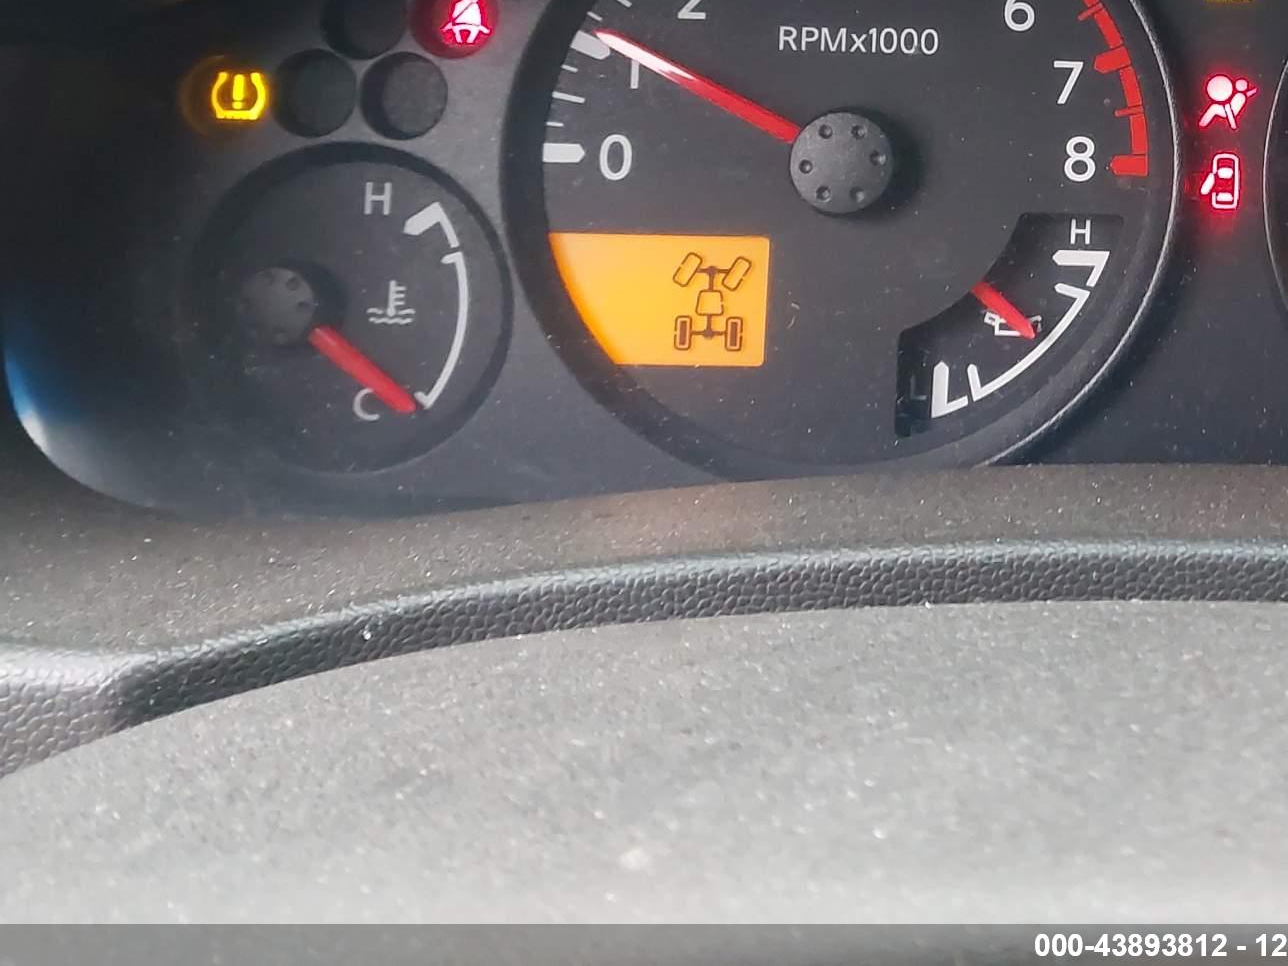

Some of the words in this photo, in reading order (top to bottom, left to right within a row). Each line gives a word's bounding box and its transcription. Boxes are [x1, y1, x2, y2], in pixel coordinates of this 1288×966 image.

[778, 25, 940, 56] RPMx1000
[1053, 60, 1084, 105] 7
[600, 134, 634, 181] 0
[1063, 135, 1096, 182] 8
[363, 181, 393, 216] H
[1068, 219, 1092, 245] H
